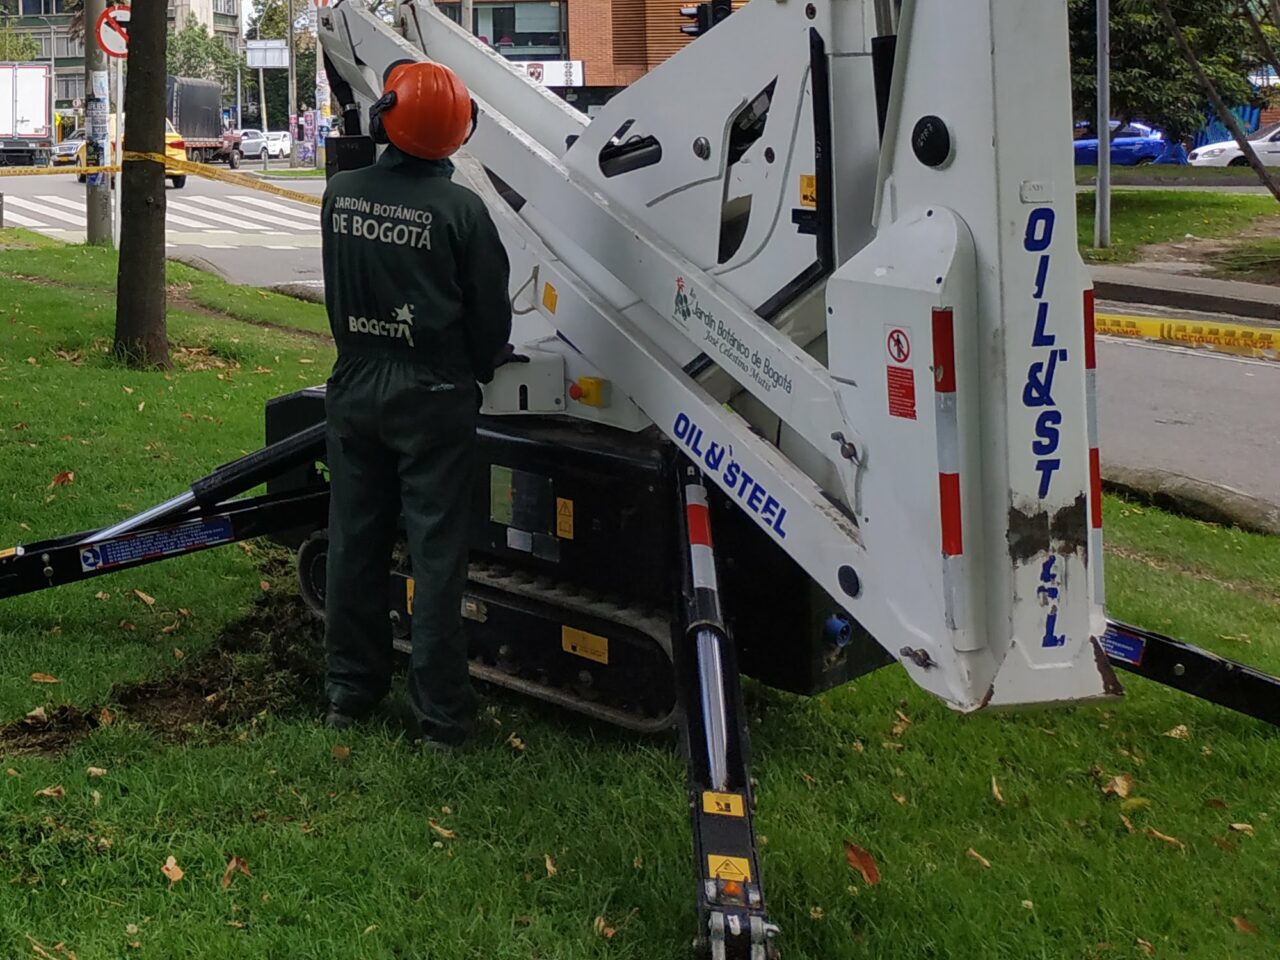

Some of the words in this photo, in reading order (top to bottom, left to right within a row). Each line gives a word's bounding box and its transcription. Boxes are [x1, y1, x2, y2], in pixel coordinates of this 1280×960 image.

[334, 196, 371, 215] JARDÍN
[373, 203, 433, 226] BOTÁNICO
[332, 214, 348, 235] DE
[352, 218, 433, 251] BOGOTÁ
[717, 319, 750, 358] Botánico
[751, 350, 762, 369] de
[763, 357, 792, 394] Bogotá
